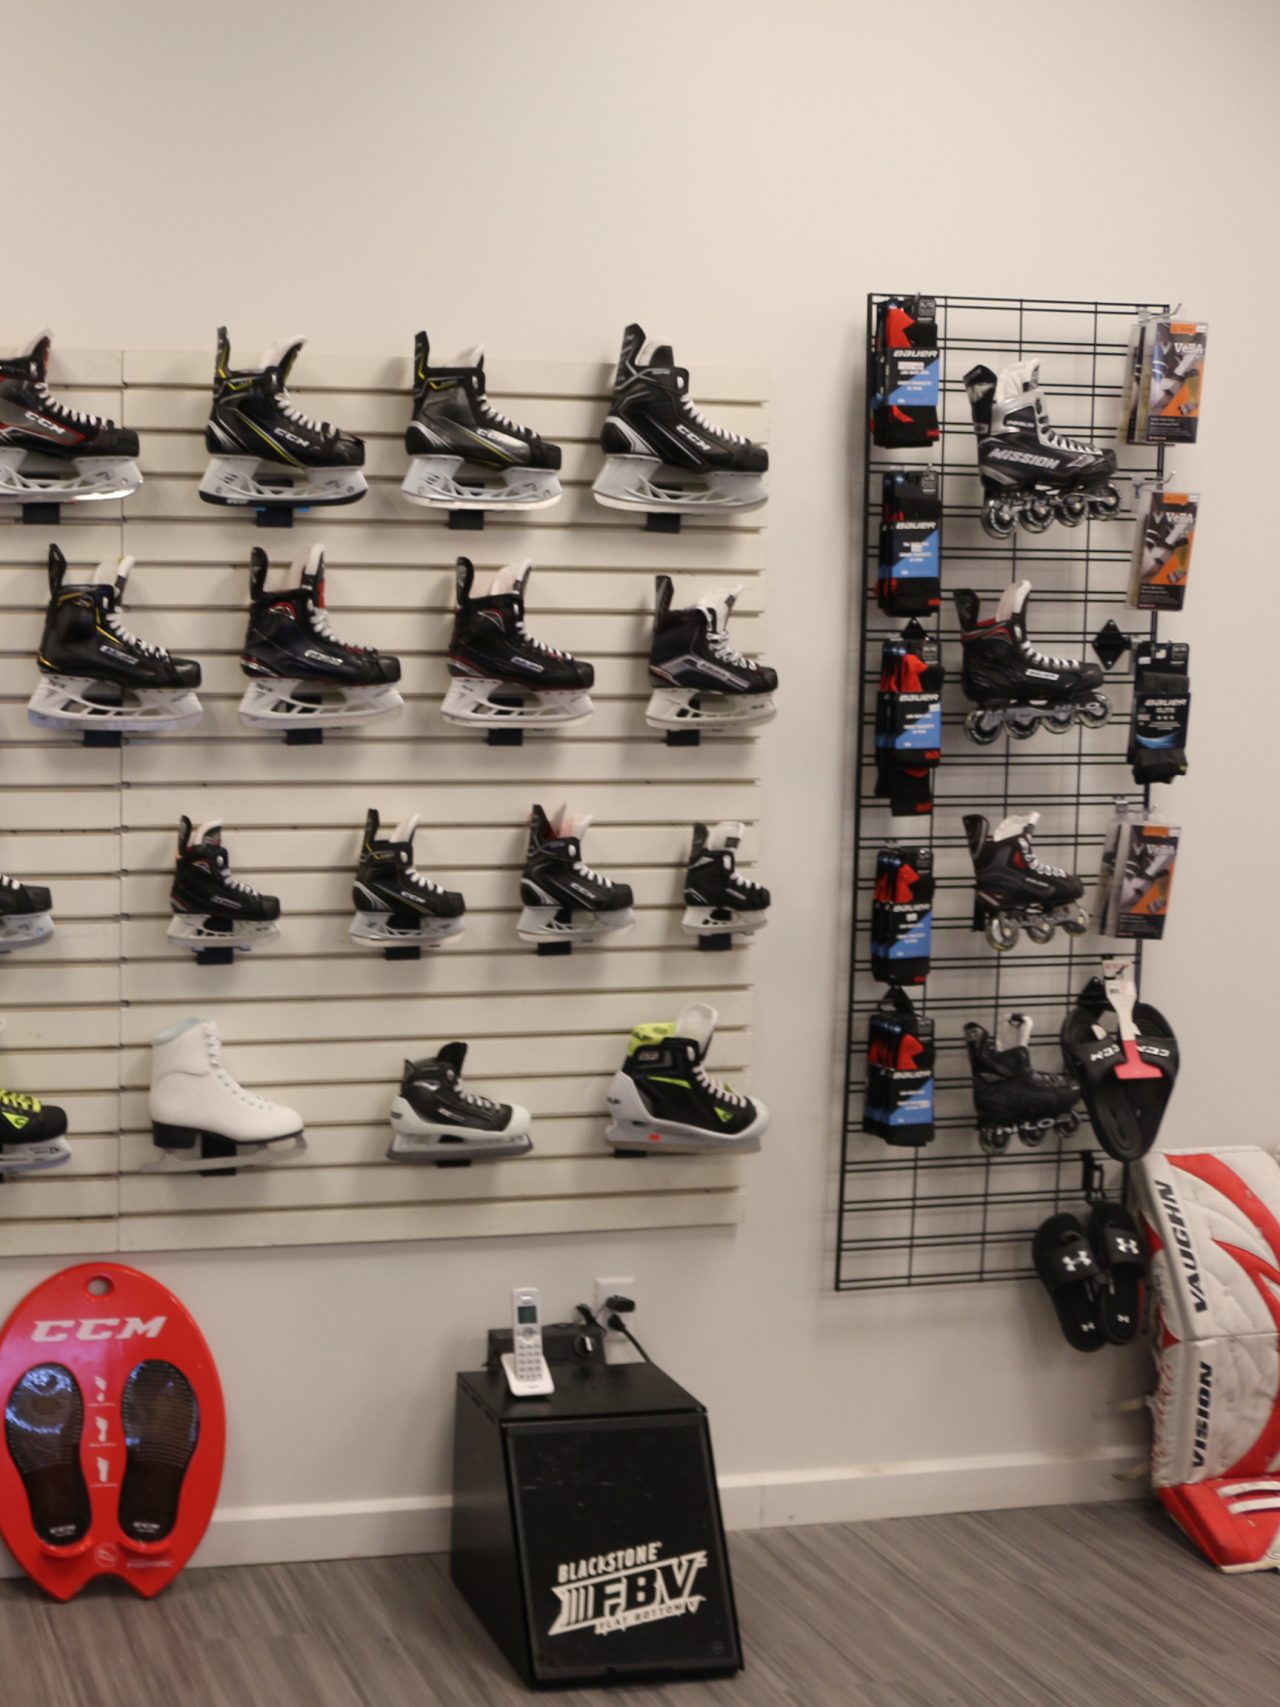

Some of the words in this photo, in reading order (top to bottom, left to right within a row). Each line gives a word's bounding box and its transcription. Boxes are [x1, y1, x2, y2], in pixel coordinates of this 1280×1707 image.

[24, 411, 66, 435] CCM
[274, 427, 310, 447] CCM
[676, 424, 711, 451] CCM
[989, 448, 1060, 470] MISSION
[1155, 1180, 1208, 1314] VAUGHN
[30, 1315, 168, 1343] CCM
[1192, 1361, 1213, 1469] VISION
[557, 1541, 659, 1584] BLACKSTONE
[594, 1559, 697, 1618] FBV
[634, 1602, 686, 1622] BOTTOM
